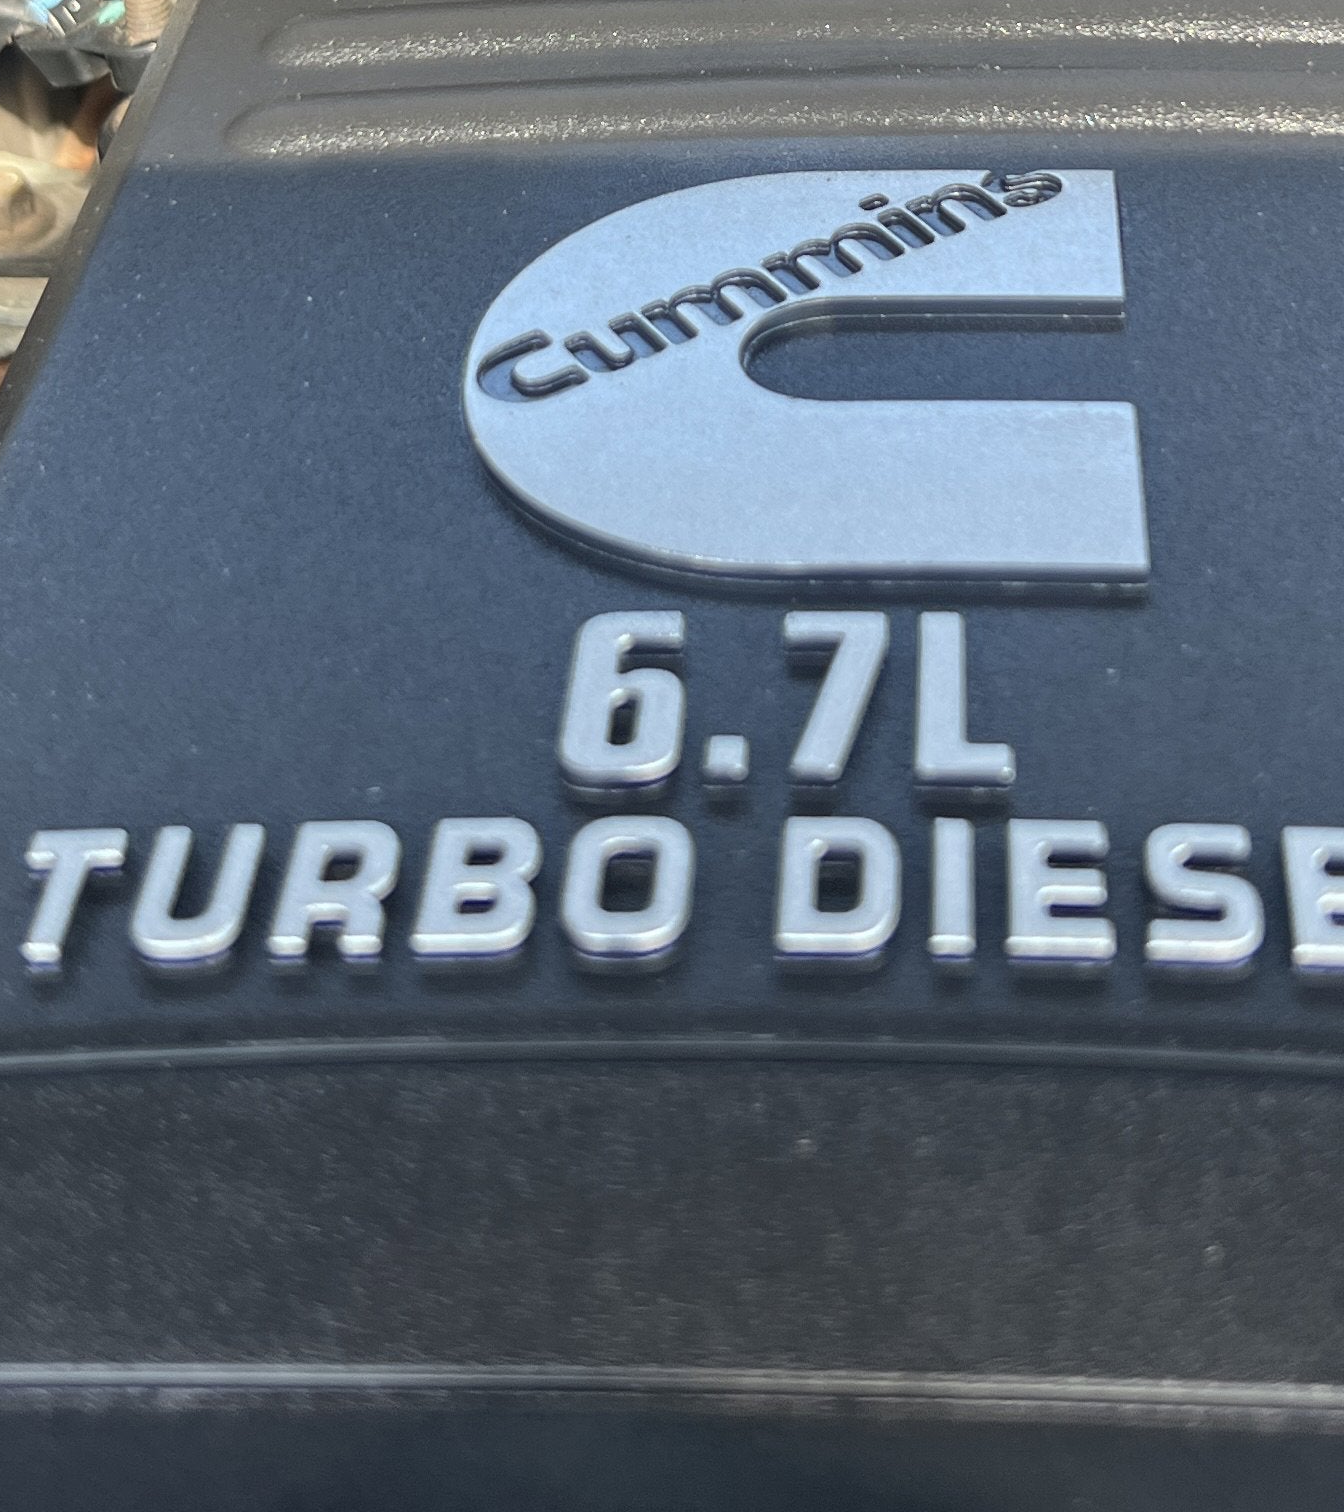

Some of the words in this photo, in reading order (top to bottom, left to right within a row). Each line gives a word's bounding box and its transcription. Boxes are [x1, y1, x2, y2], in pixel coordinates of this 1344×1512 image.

[476, 171, 1062, 402] Cummins
[557, 611, 1015, 790] 6.7L
[20, 815, 696, 970] TURBO
